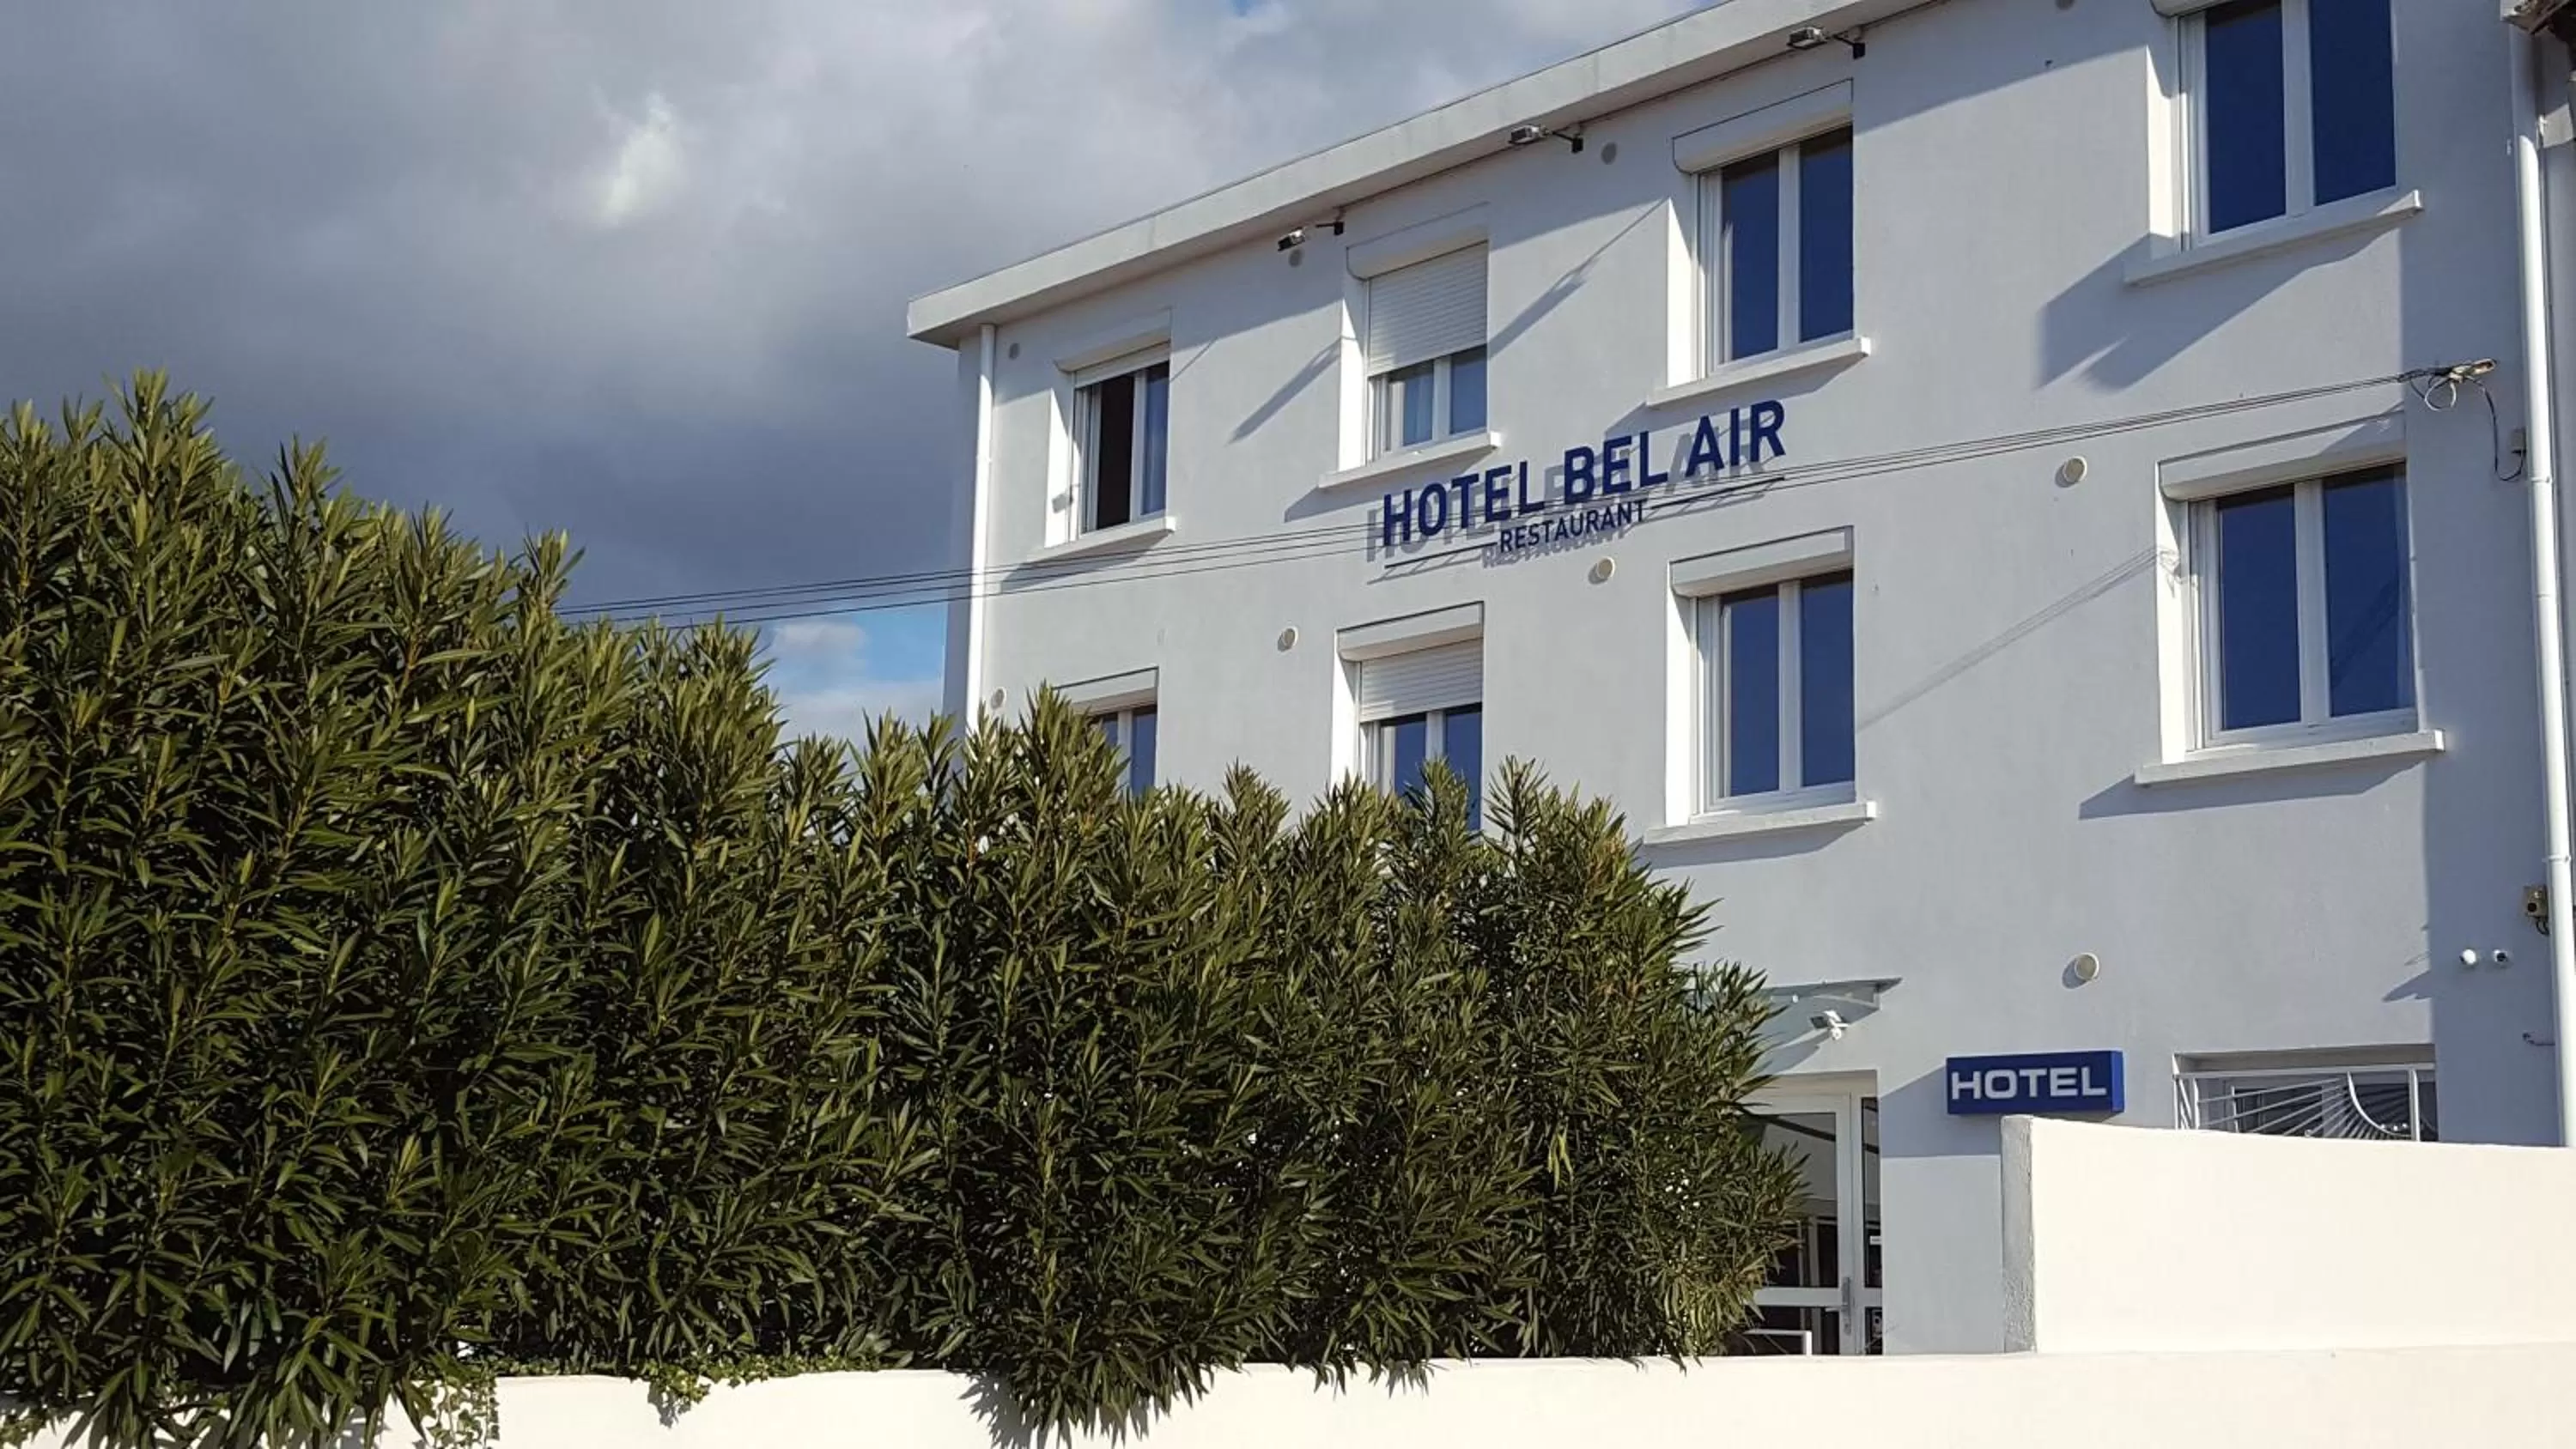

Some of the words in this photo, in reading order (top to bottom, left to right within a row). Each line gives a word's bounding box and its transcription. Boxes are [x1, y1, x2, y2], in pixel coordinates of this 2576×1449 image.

[1383, 461, 1545, 547] HOTEL
[1564, 430, 1668, 505] BEL
[1686, 399, 1786, 477] AIR
[1499, 499, 1649, 553] RESTAURANT
[1951, 1067, 2106, 1100] HOTEL
